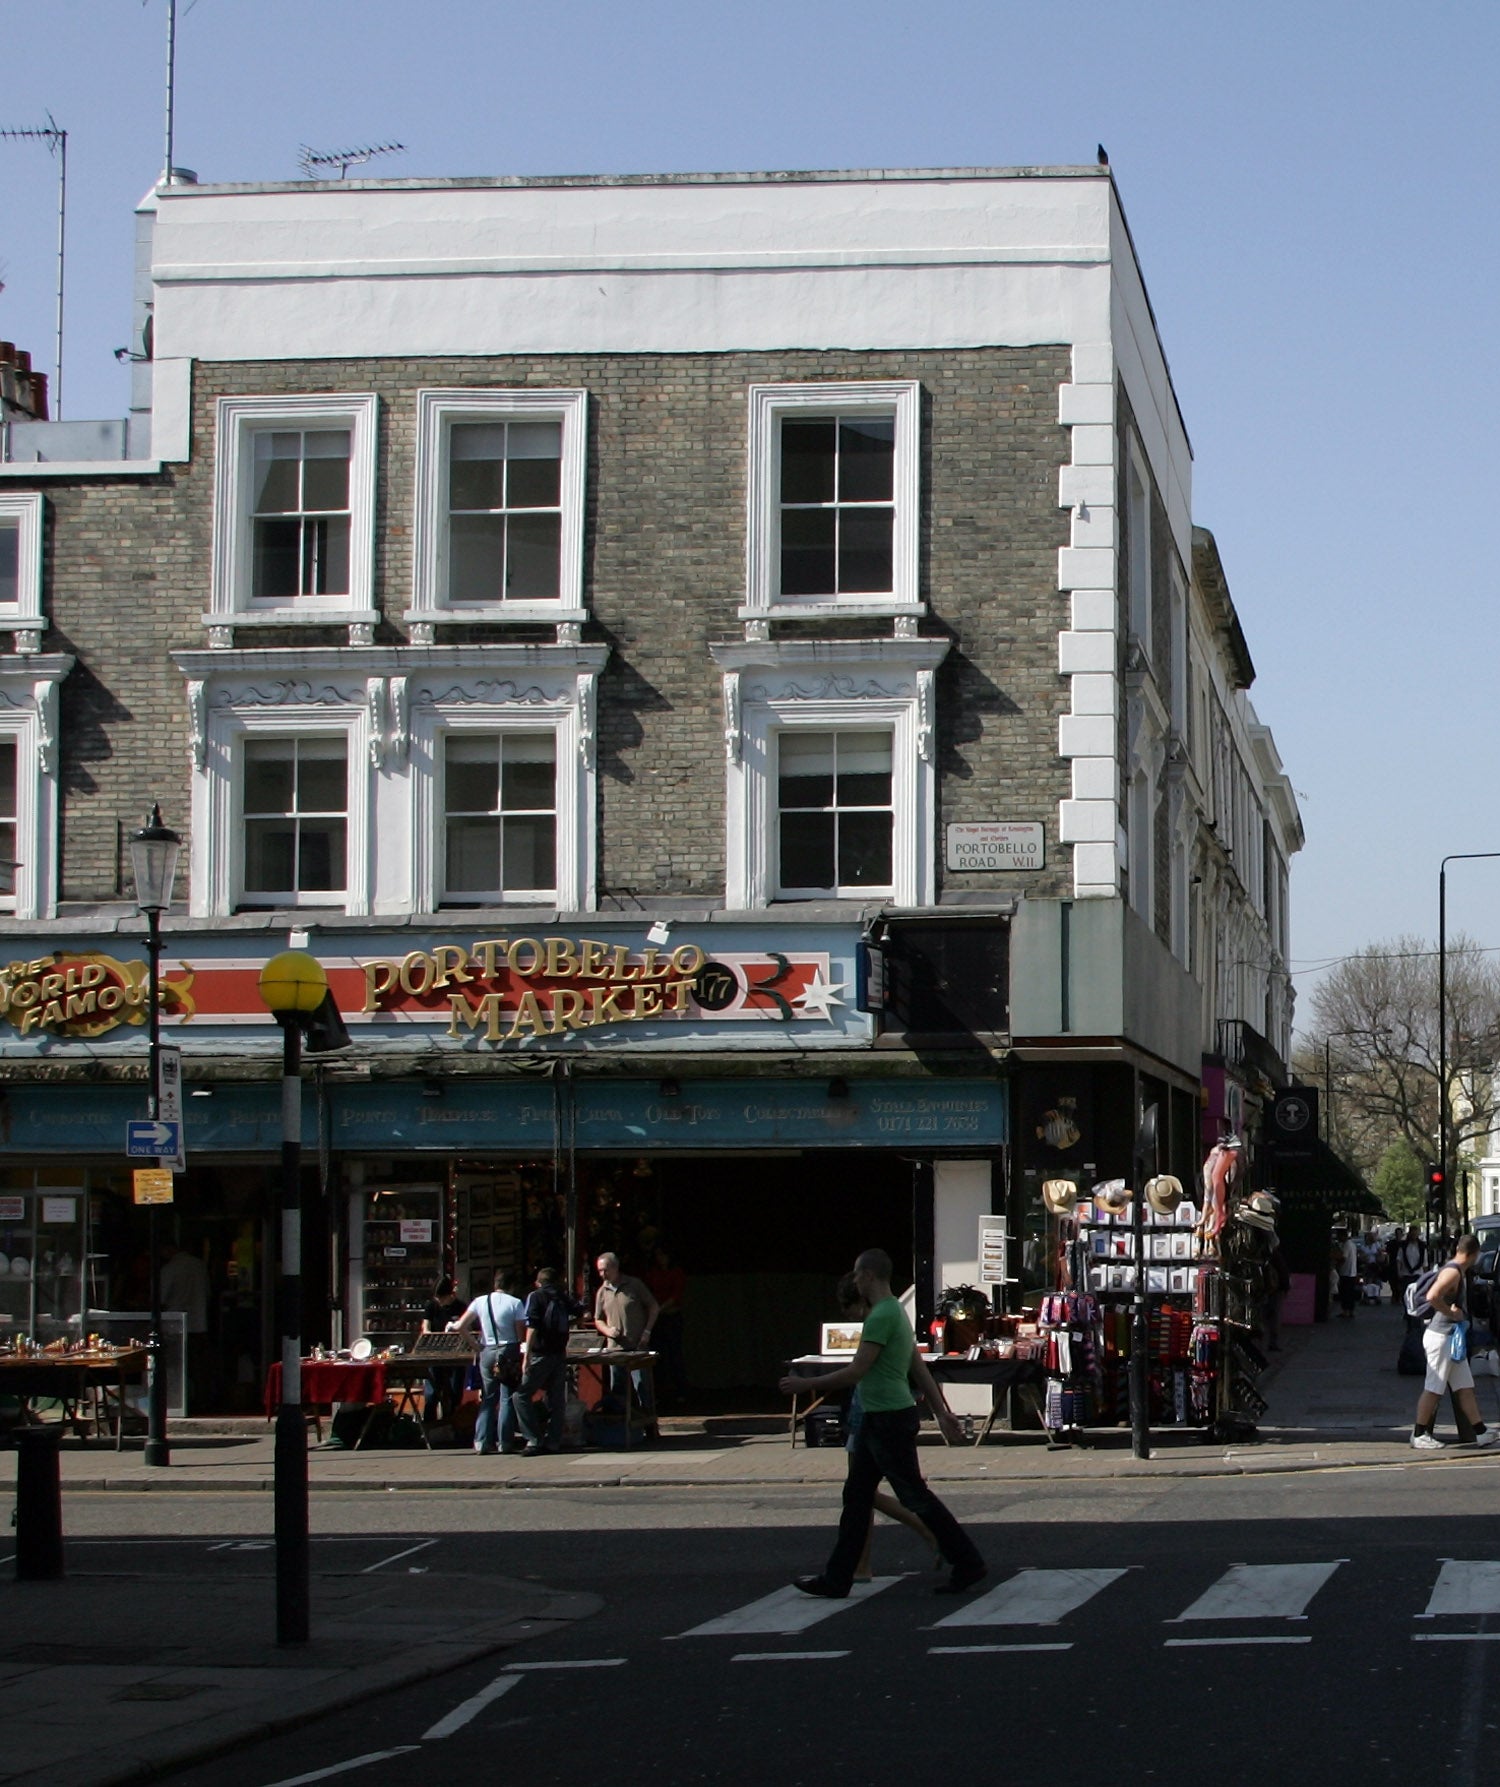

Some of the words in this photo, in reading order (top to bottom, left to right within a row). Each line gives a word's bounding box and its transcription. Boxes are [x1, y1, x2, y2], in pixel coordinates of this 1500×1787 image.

[955, 842, 1037, 855] PORTOBELLO
[959, 856, 996, 868] ROAD
[361, 937, 705, 1014] PORTOBELLO
[699, 971, 731, 1002] 177
[446, 978, 697, 1041] MARKET
[130, 1145, 151, 1154] ONE
[157, 1145, 175, 1154] WAY
